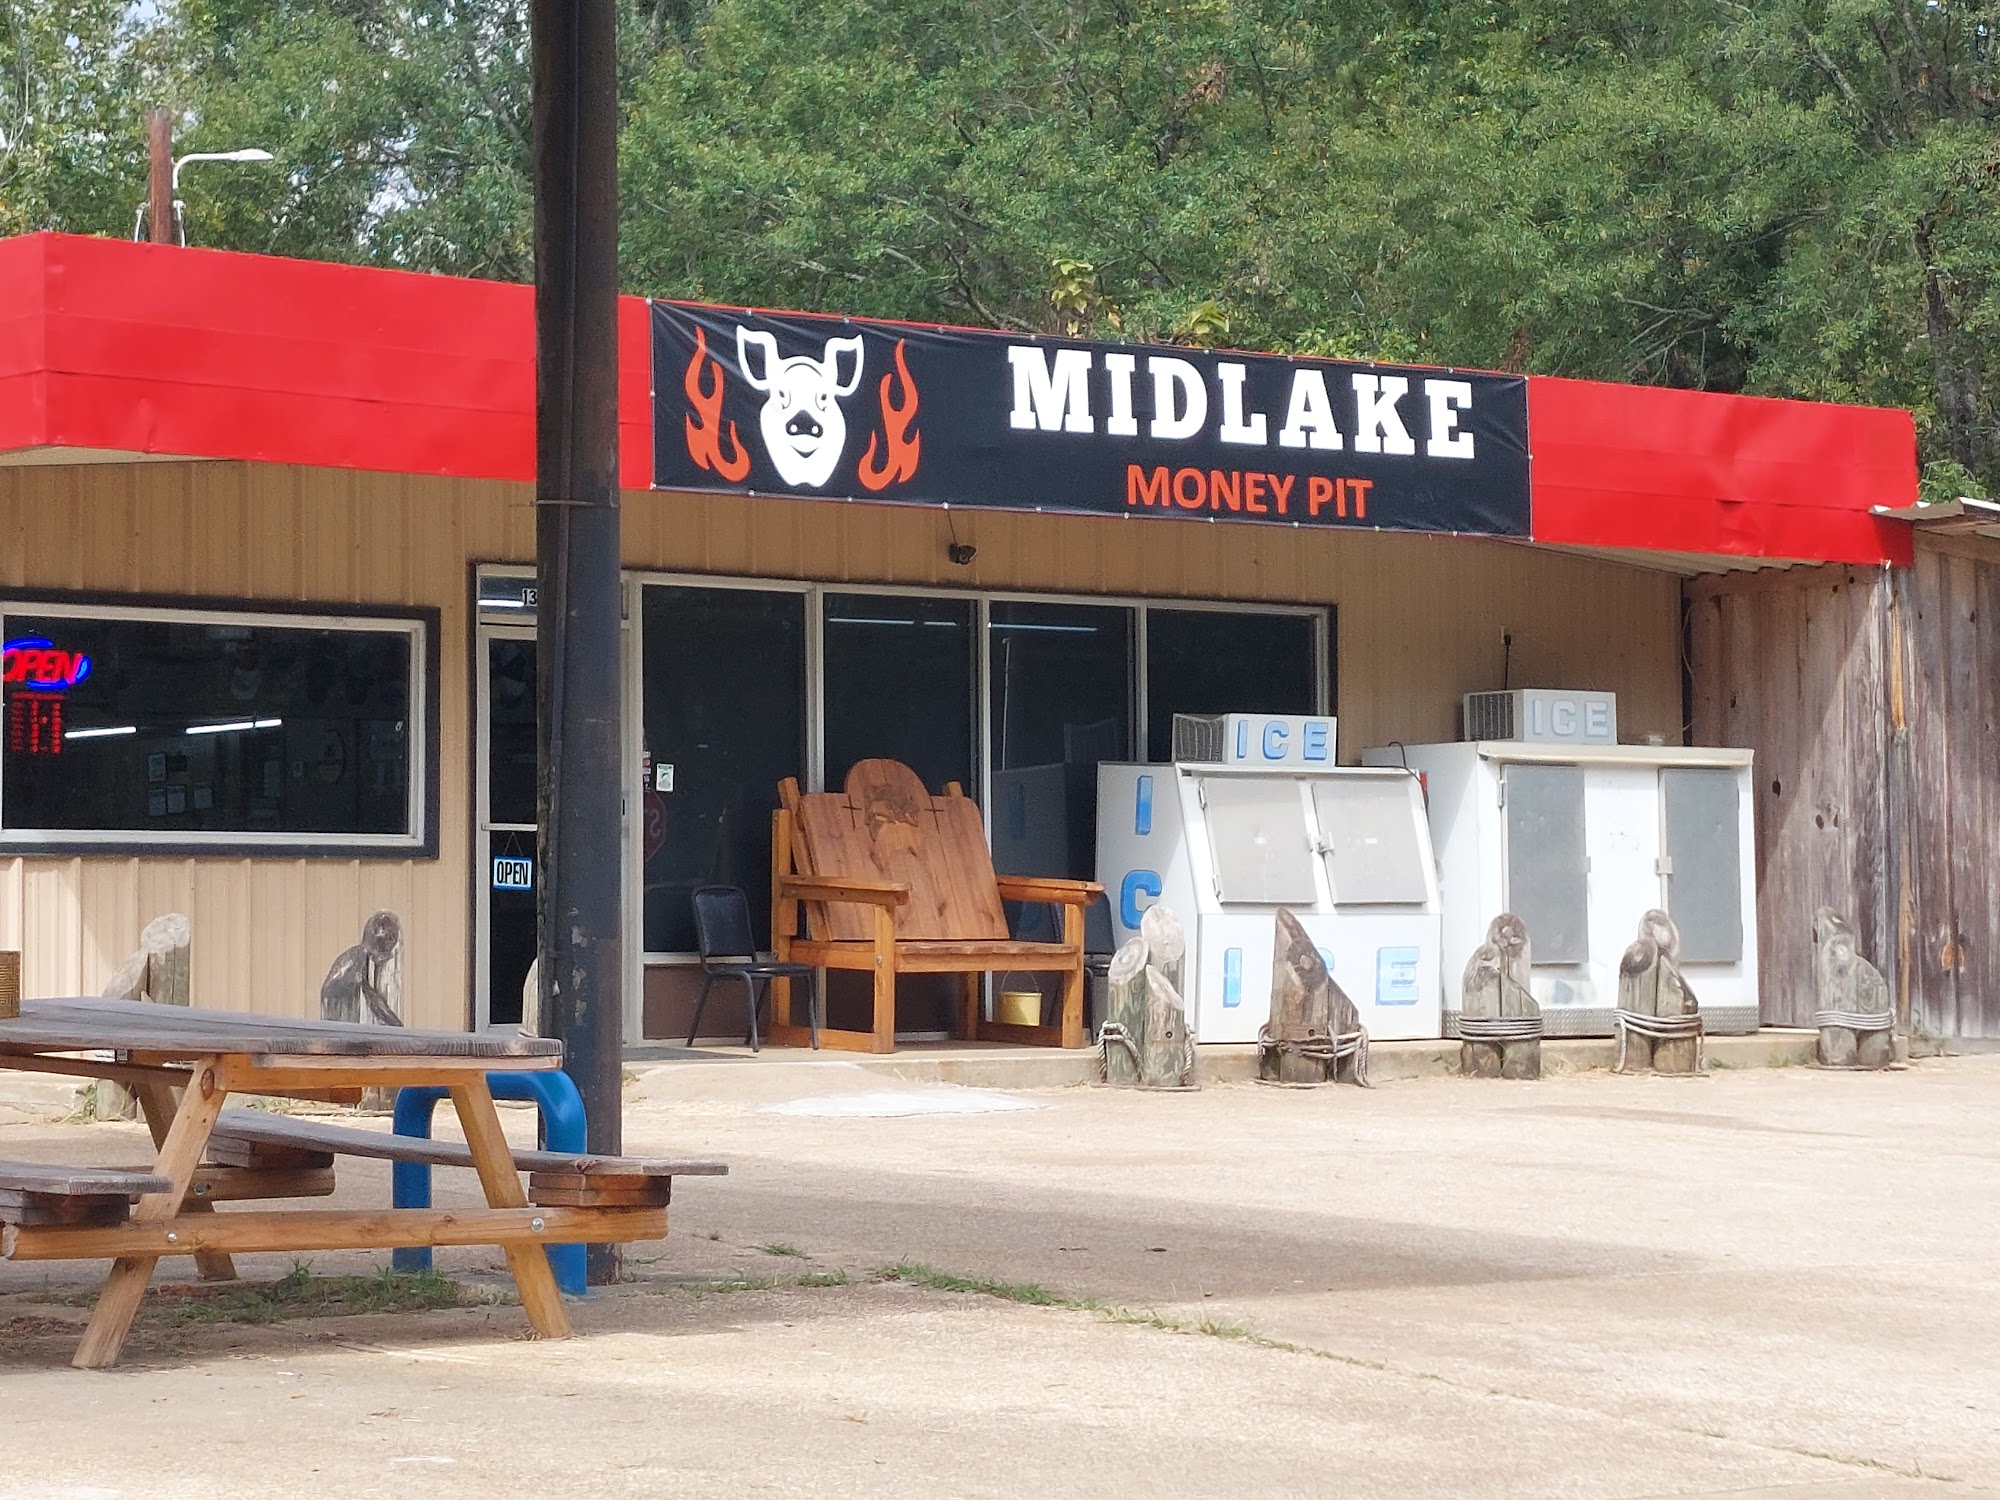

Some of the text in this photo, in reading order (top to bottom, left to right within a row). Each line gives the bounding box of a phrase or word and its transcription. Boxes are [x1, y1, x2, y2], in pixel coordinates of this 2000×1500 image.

[1008, 345, 1475, 459] MIDLAKE
[1126, 464, 1374, 518] MONEY PIT
[3, 648, 83, 685] OPEN
[1531, 700, 1610, 737] ICE
[1236, 719, 1329, 761] ICE
[496, 860, 529, 885] OPEN
[1222, 946, 1420, 1008] IE
